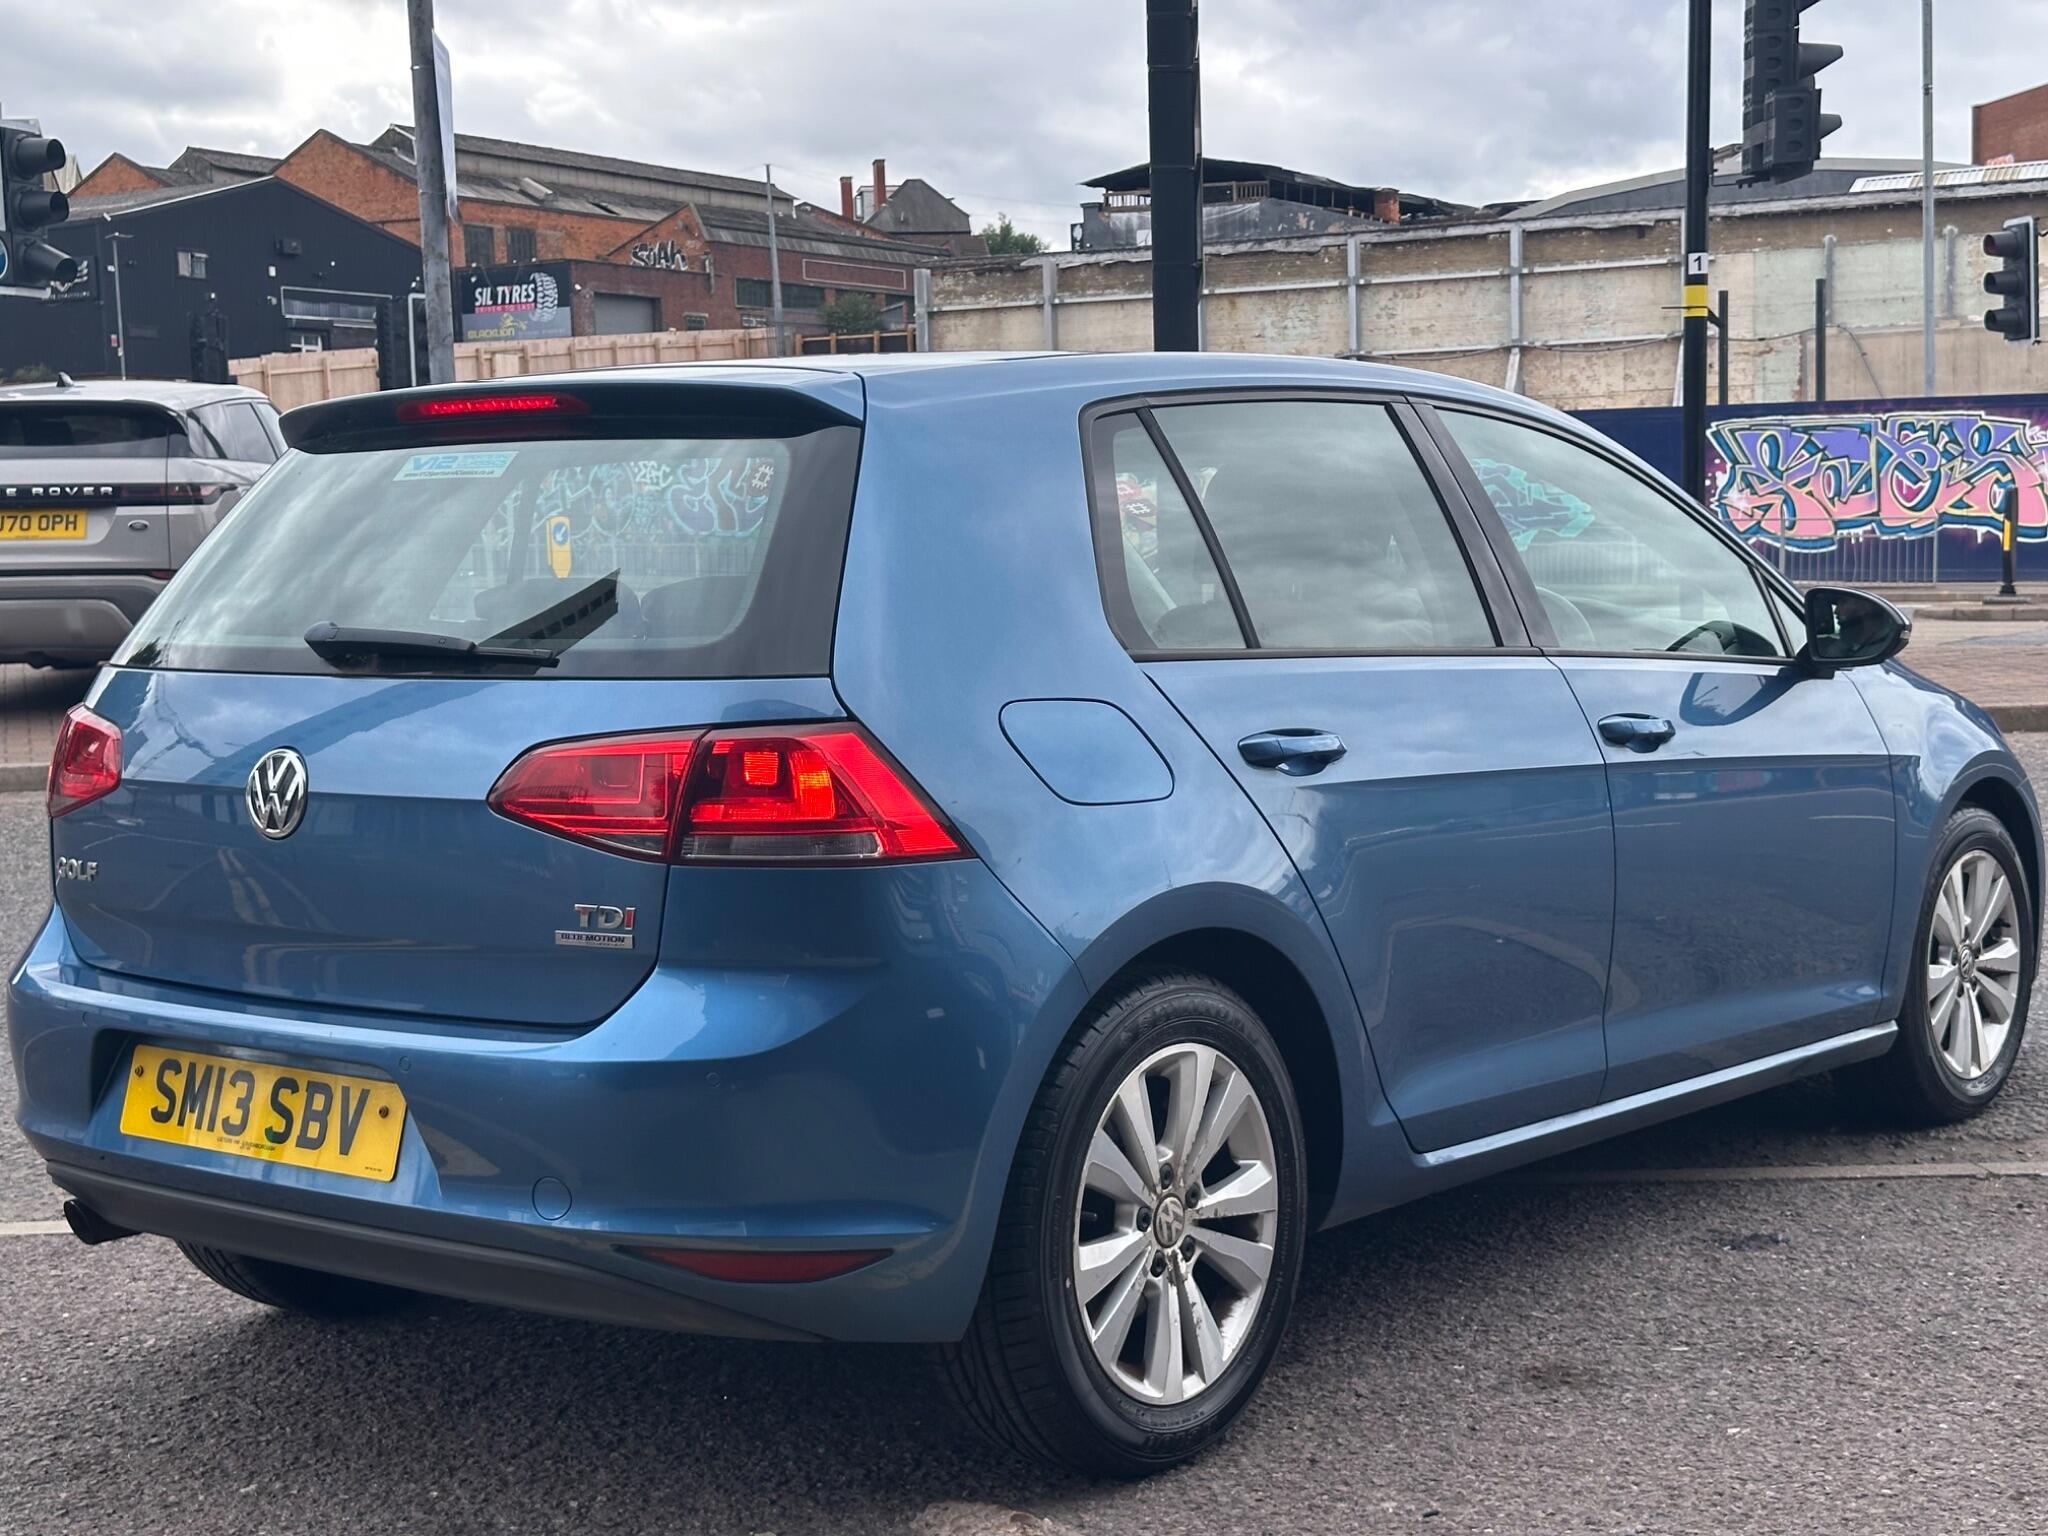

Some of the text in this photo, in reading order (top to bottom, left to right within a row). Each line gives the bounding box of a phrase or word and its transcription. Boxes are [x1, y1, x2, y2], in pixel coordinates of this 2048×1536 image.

[1693, 255, 1702, 271] 1
[475, 283, 535, 306] SIL TYRES
[31, 486, 113, 496] ROVER
[38, 514, 78, 531] OPH
[58, 856, 98, 882] GOLF
[574, 903, 636, 930] TDI
[150, 1057, 371, 1156] SM13 SBV
